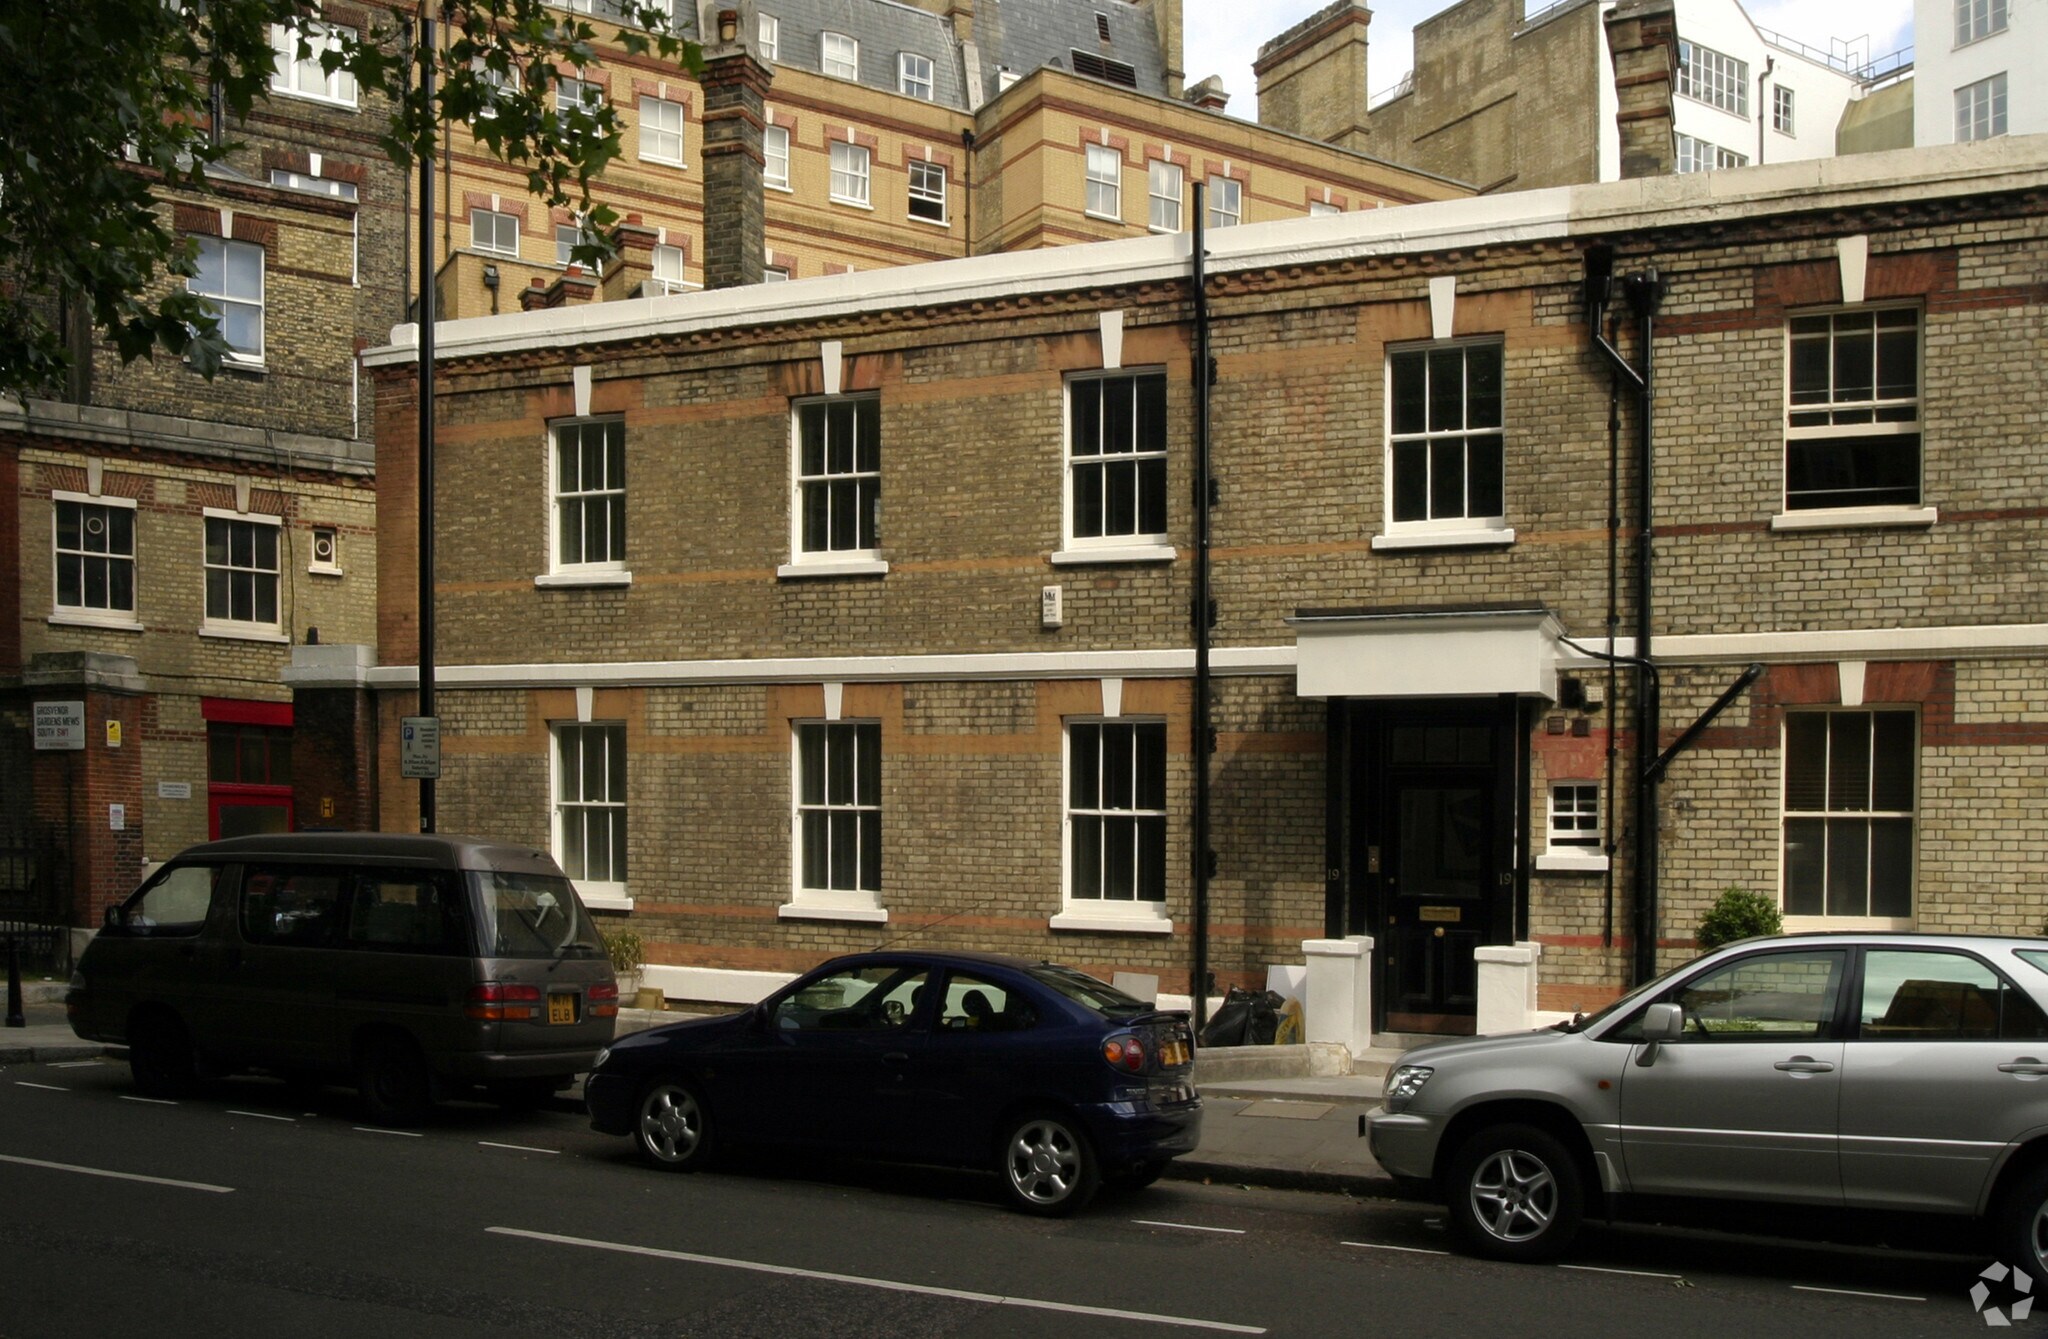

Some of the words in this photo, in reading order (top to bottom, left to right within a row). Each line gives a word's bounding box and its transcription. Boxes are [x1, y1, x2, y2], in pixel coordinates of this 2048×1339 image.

[36, 706, 69, 715] GROSVENOR
[36, 716, 62, 726] GARDENS
[62, 716, 80, 726] MEWS
[36, 728, 55, 737] SOUTH
[56, 728, 69, 737] SW1
[1328, 868, 1340, 881] 19
[1499, 872, 1512, 885] 19
[552, 1009, 570, 1021] ELB
